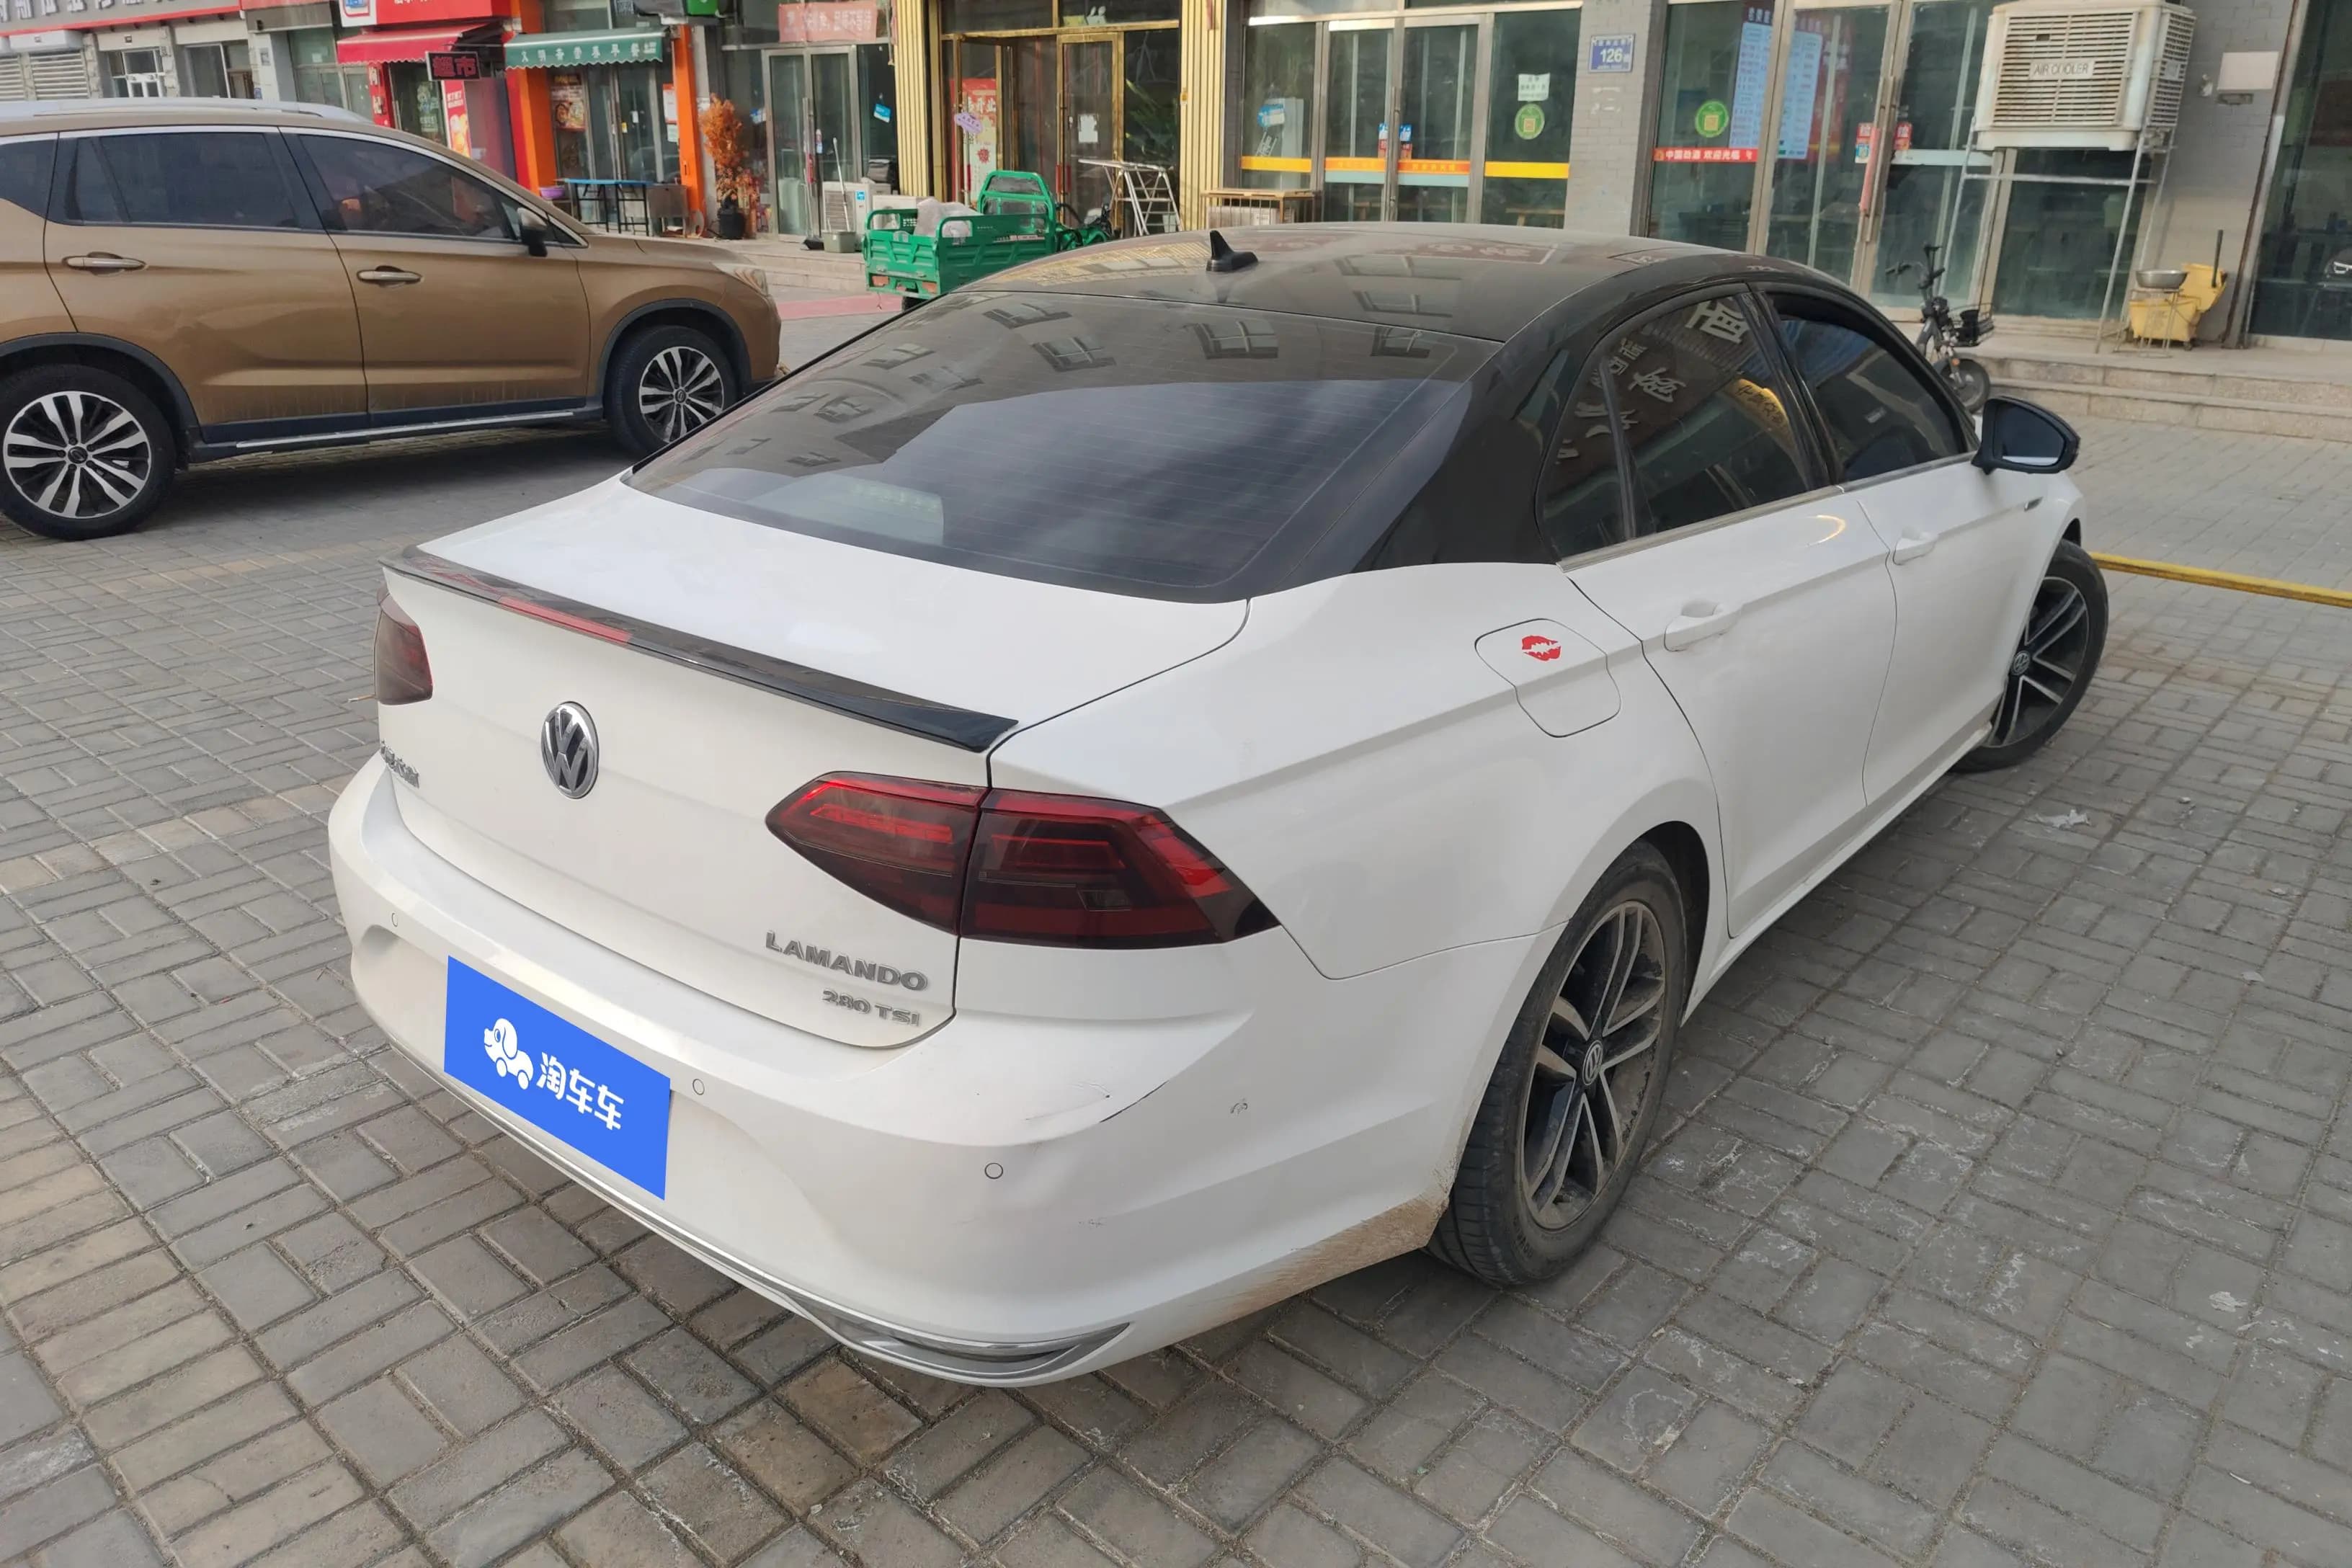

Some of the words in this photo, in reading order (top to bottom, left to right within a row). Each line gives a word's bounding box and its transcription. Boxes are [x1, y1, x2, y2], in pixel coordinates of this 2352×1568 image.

[2034, 63, 2049, 76] AIR
[765, 930, 927, 991] LAMANDO
[822, 989, 871, 1015] 280
[874, 1002, 920, 1026] TSI
